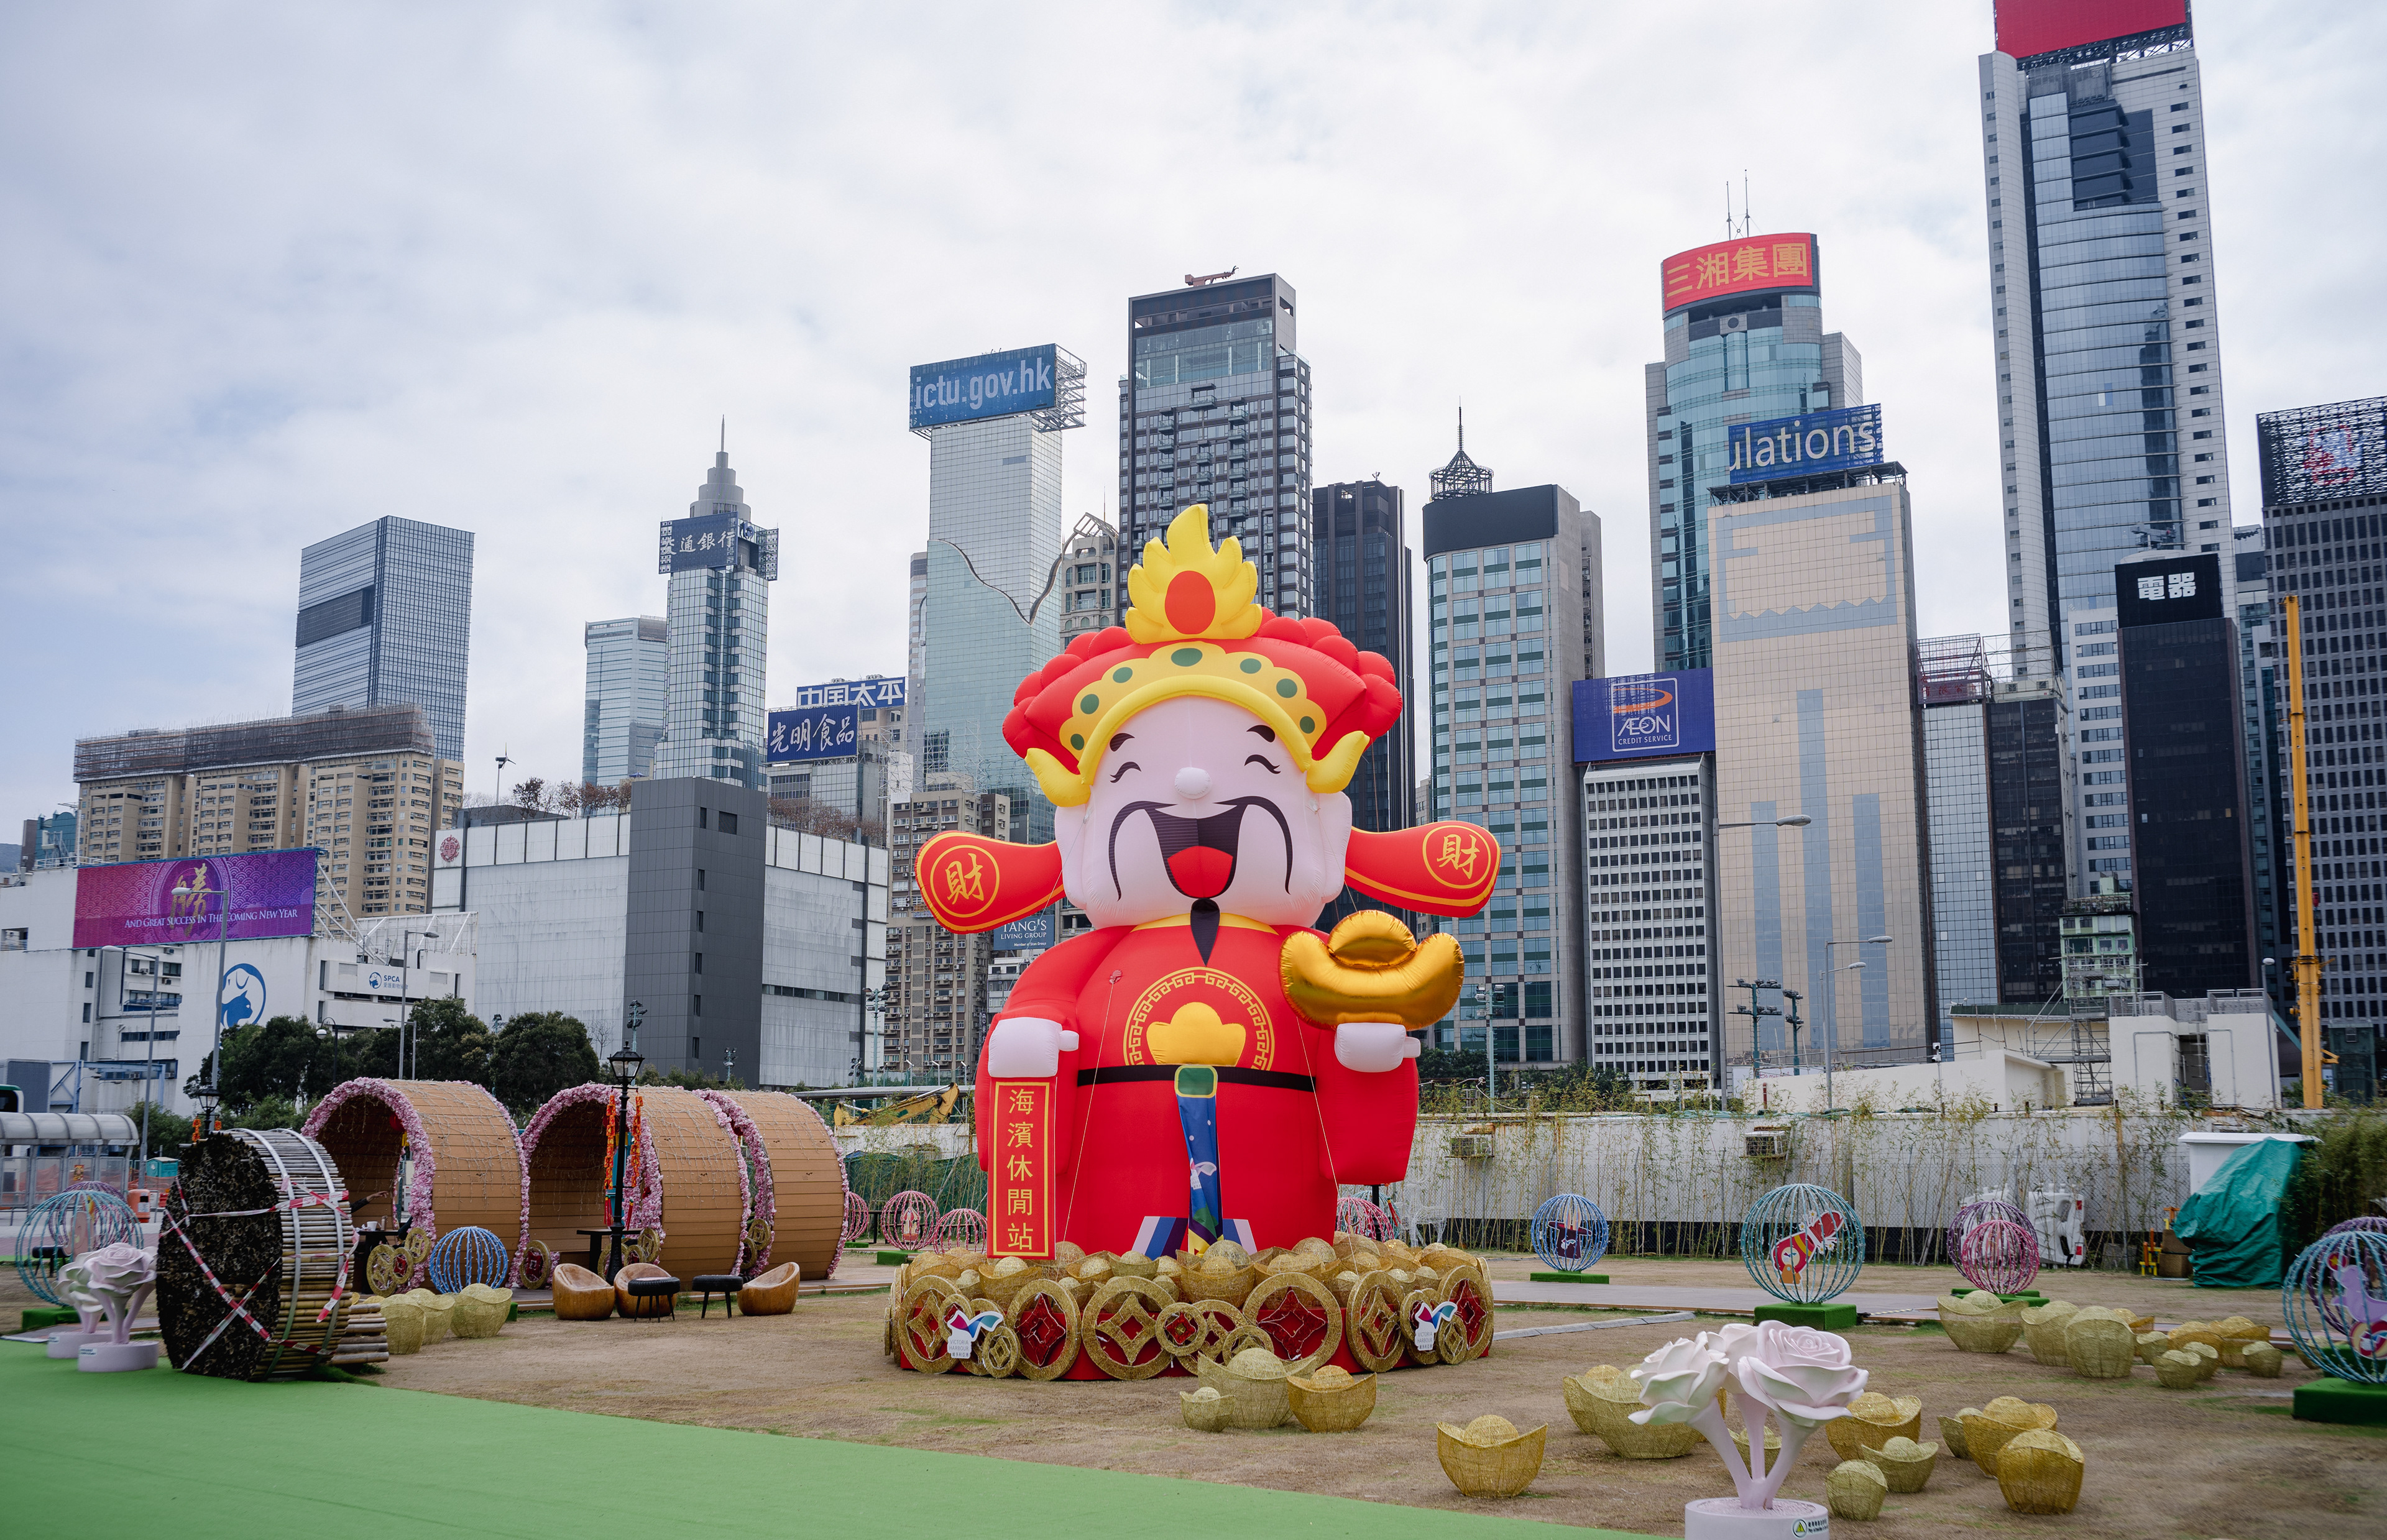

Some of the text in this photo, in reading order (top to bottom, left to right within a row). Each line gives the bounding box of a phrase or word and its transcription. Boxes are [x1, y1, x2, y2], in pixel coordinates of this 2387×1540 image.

[1667, 243, 1807, 298] 三湘集團
[915, 357, 1052, 410] ictu.gov.hk
[2137, 572, 2196, 600] 電器
[770, 713, 855, 753] 光明食品
[1618, 735, 1672, 745] CREDIT SERVICE
[945, 853, 984, 905] 財
[1437, 834, 1480, 879] 財
[124, 919, 142, 928] AND
[143, 918, 165, 927] GREAT
[167, 916, 196, 925] SUCCESS
[198, 914, 206, 924] IN
[259, 910, 278, 919] NEW
[279, 909, 298, 918] YEAR
[1006, 1088, 1034, 1250] 海濱休閒站
